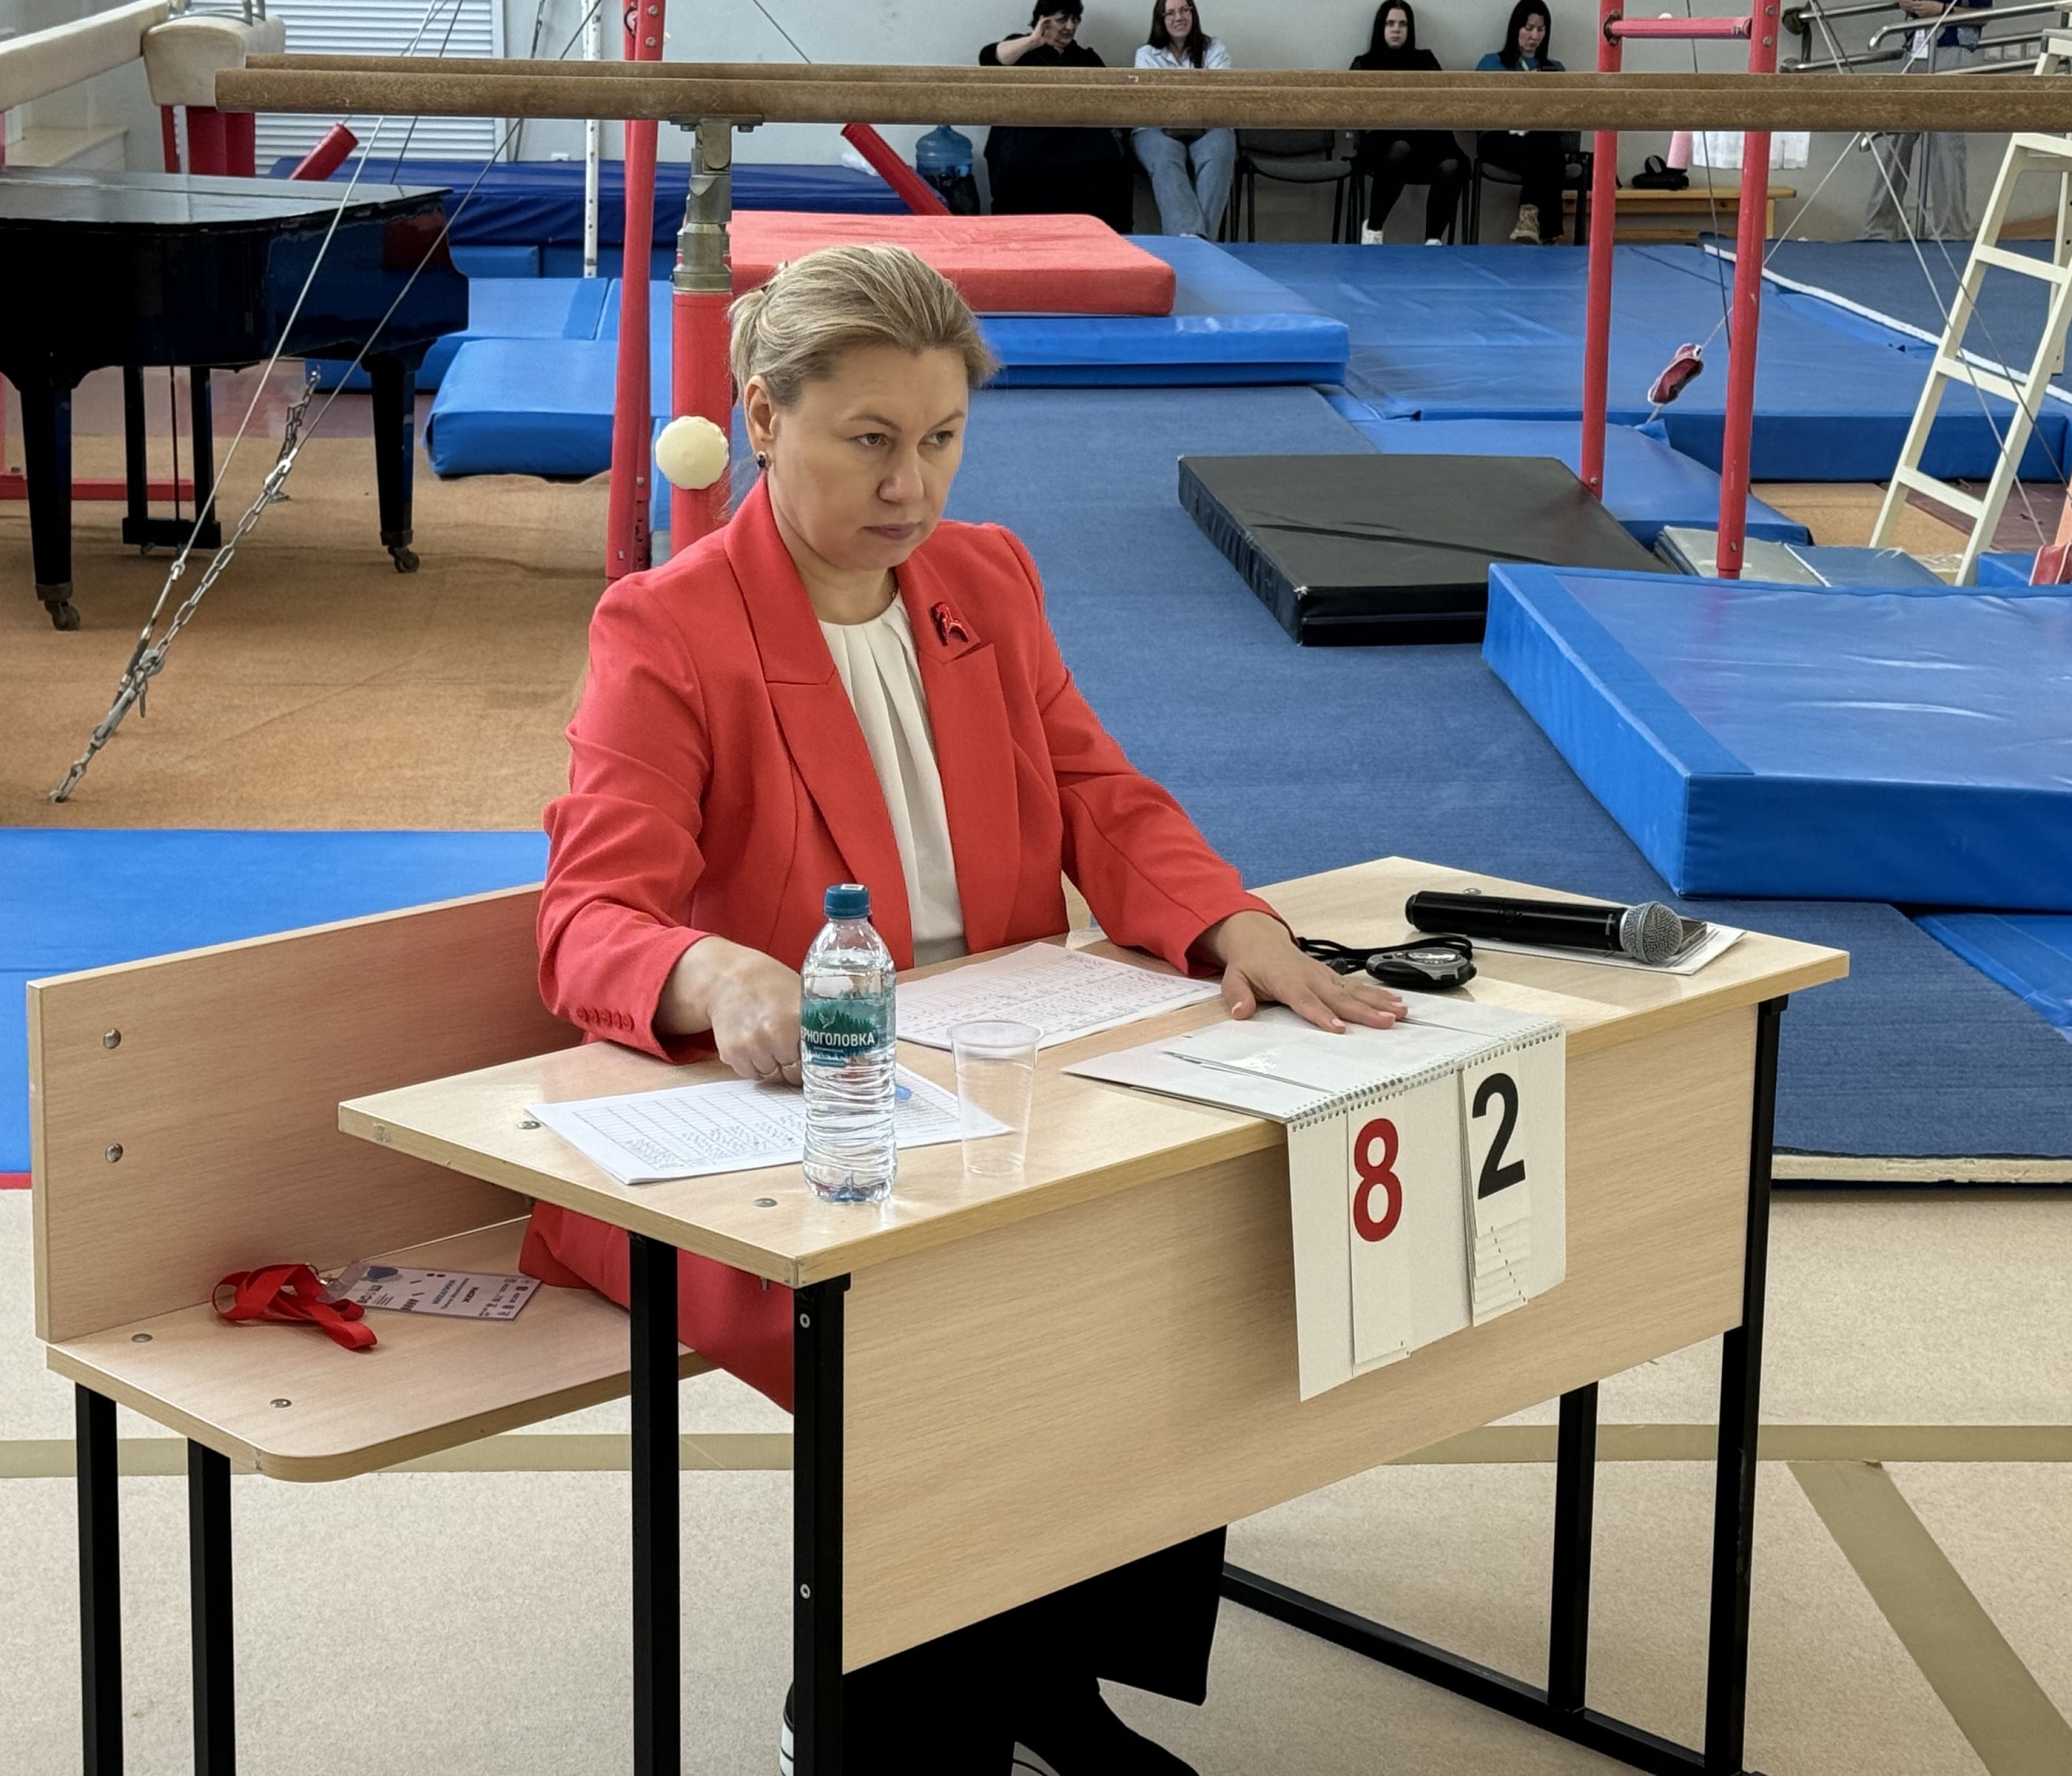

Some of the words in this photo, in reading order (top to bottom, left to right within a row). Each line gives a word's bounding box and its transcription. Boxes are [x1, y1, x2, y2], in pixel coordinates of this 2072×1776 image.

[801, 1026, 875, 1047] ЕРНОГОЛОВКА
[1353, 1118, 1402, 1242] 8
[1472, 1072, 1526, 1200] 2
